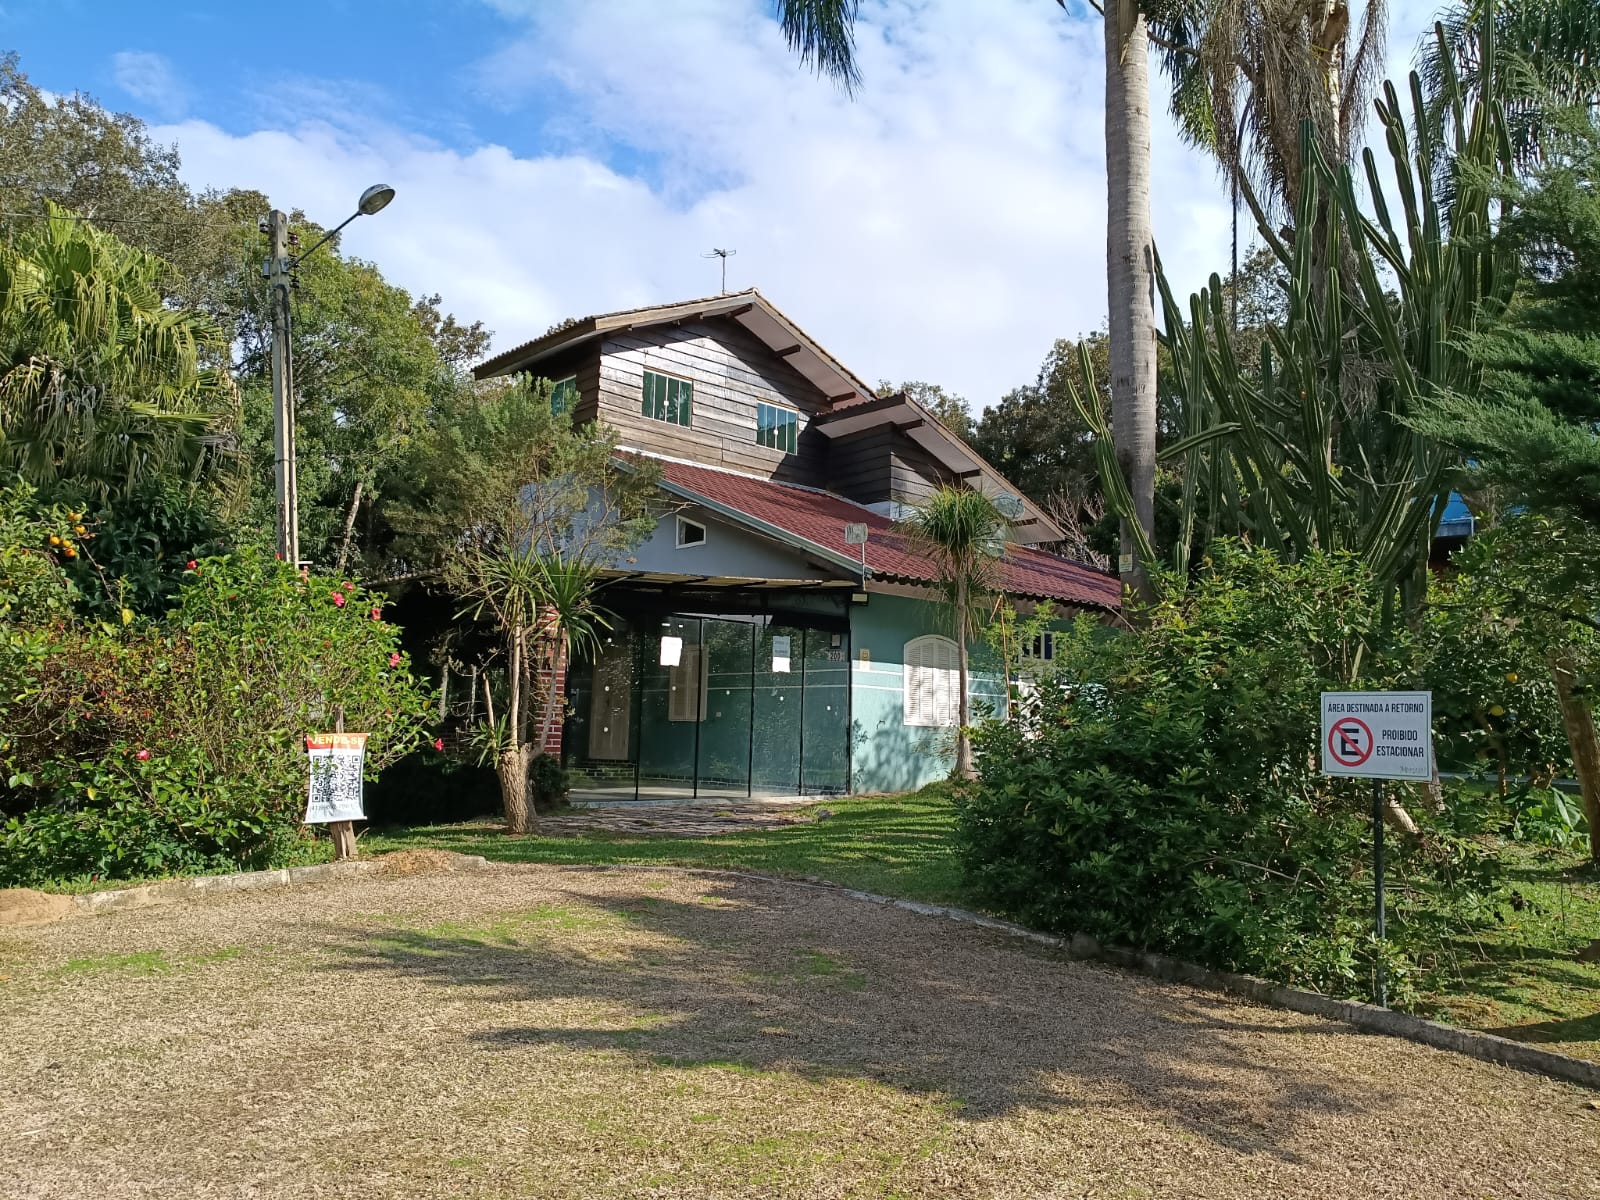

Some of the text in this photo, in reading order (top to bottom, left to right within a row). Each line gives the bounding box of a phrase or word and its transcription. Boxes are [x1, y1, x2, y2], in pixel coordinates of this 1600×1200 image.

[1346, 703, 1384, 713] DESTINADA
[1384, 703, 1390, 713] A
[1391, 703, 1424, 713] RETORNO
[1382, 729, 1418, 741] PROIBIDO
[1376, 745, 1424, 758] ESTACIONAR
